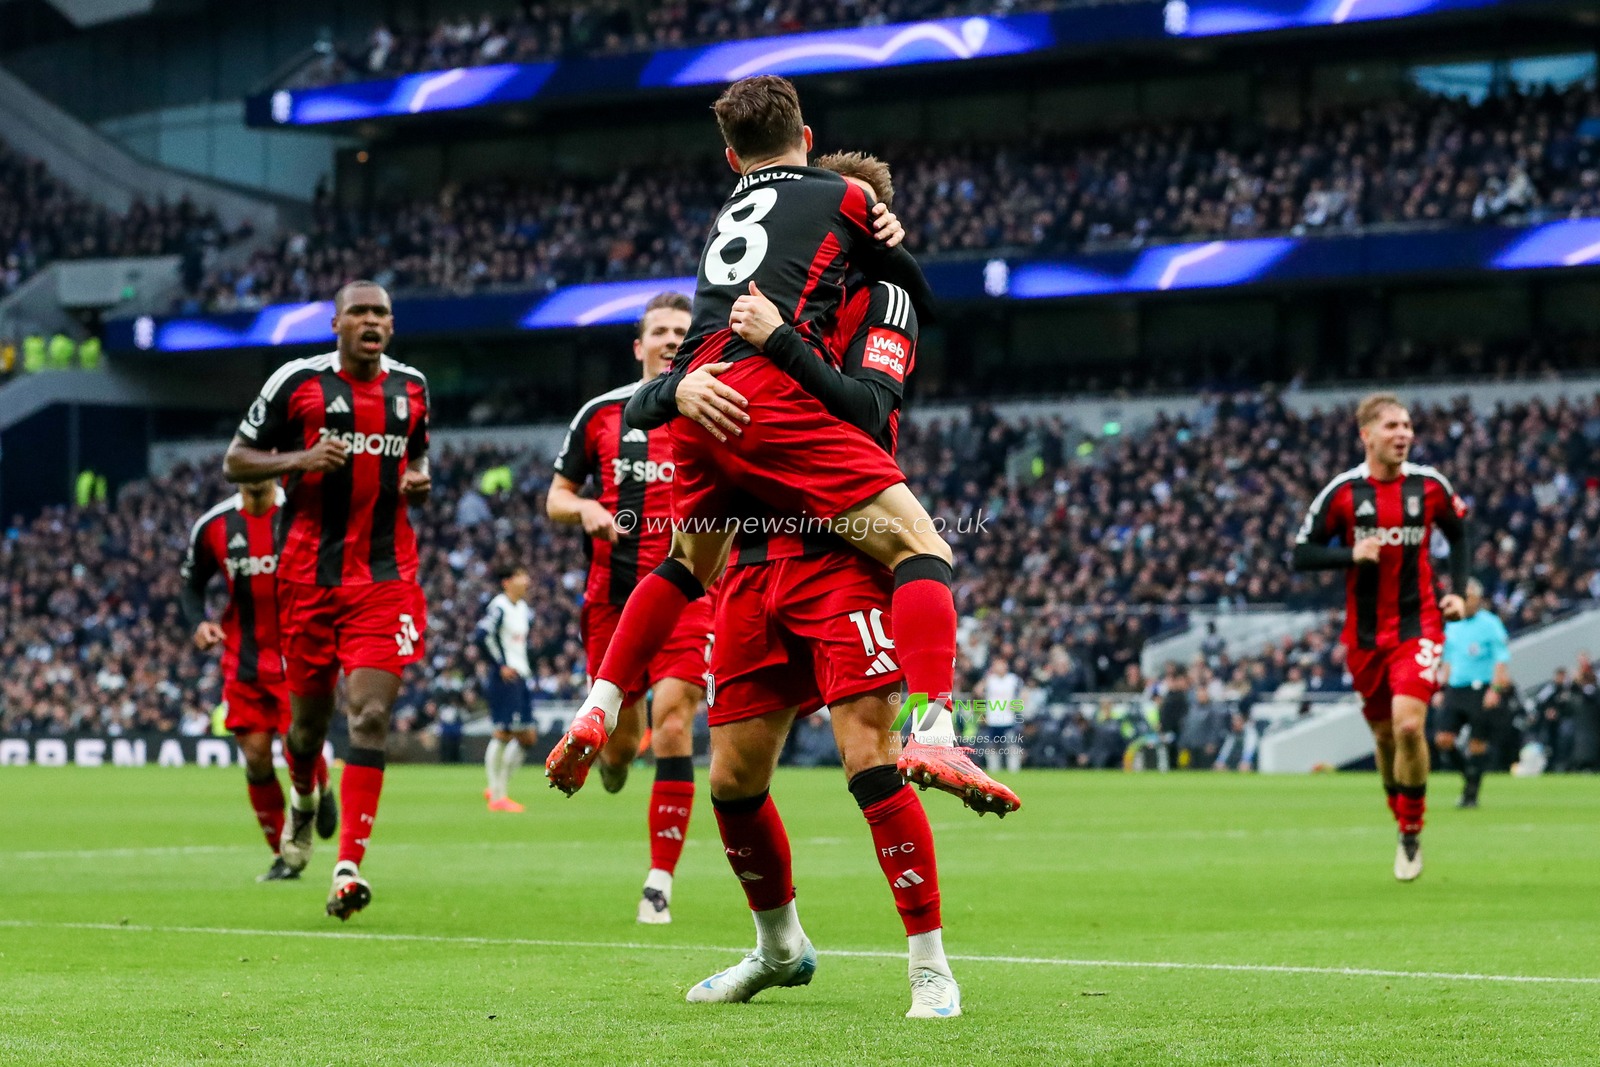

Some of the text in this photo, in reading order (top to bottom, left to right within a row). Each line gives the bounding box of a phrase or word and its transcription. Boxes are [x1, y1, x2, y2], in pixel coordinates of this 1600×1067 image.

[704, 187, 777, 286] 8
[872, 335, 905, 359] Web
[866, 347, 905, 375] Beds
[881, 841, 915, 858] FFC
